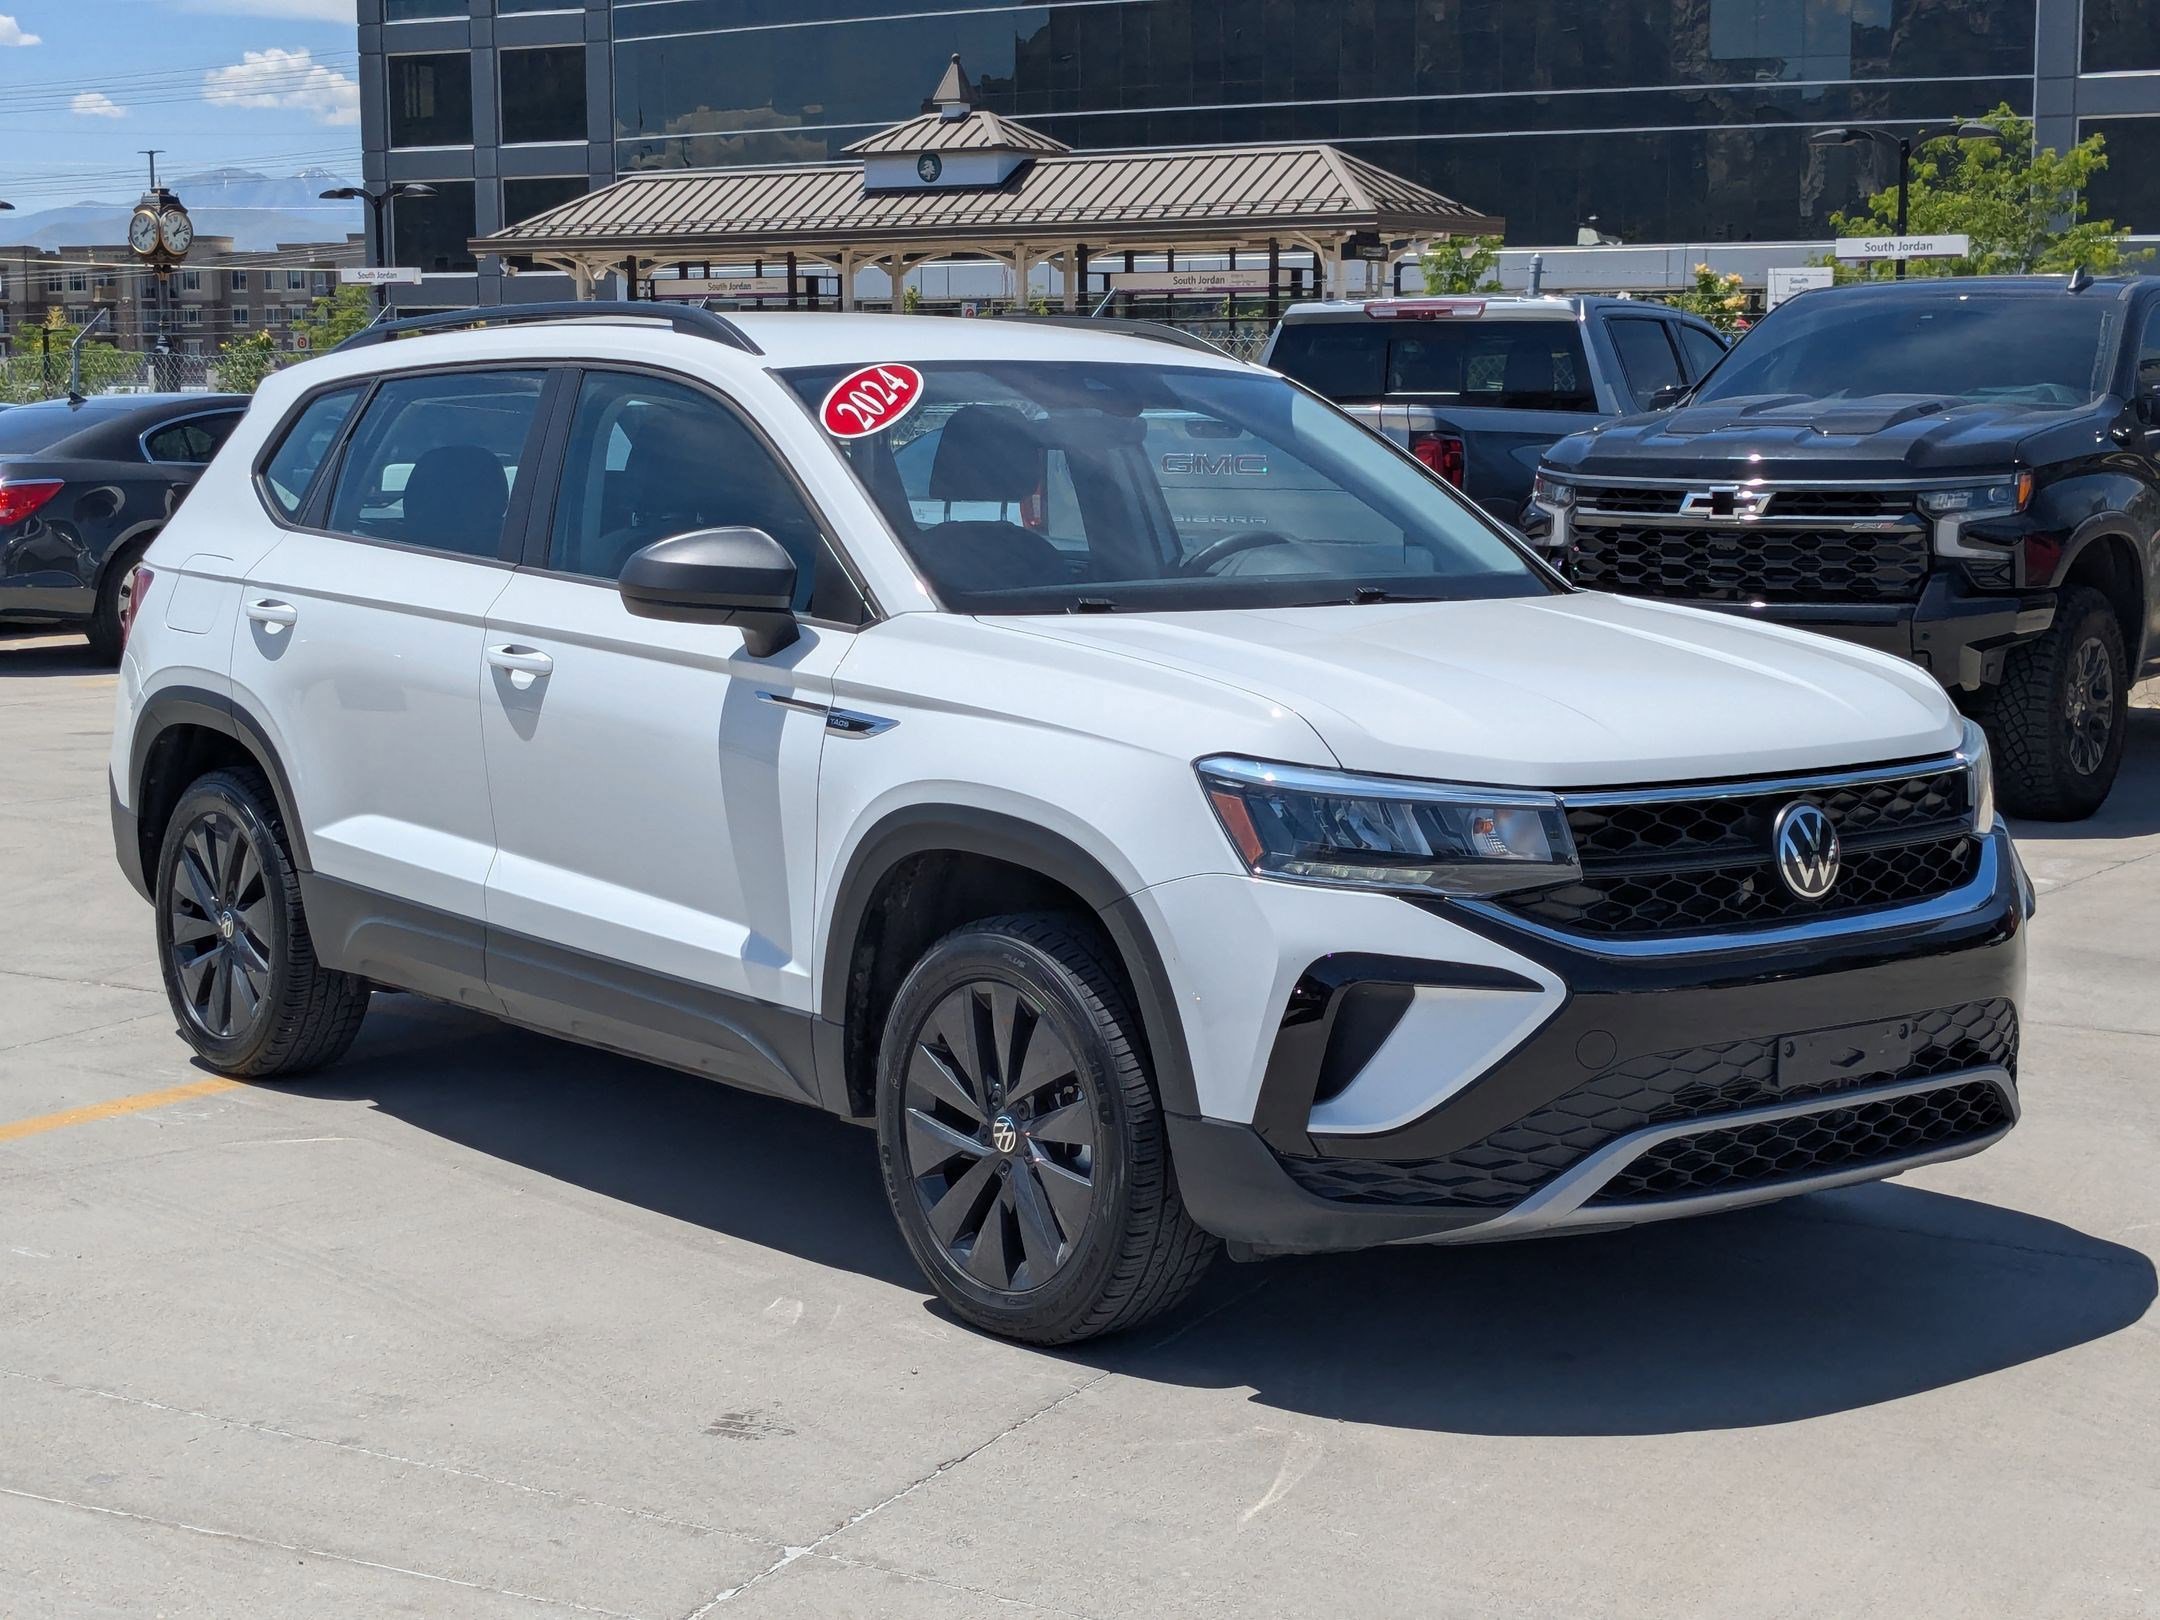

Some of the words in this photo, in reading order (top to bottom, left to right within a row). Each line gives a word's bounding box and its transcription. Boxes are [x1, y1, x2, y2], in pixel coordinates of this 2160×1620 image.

[1864, 241, 1895, 252] South
[1897, 240, 1933, 251] Jordan
[357, 271, 375, 279] South
[377, 271, 397, 279] Jordan
[1173, 275, 1197, 285] South
[1198, 275, 1225, 285] Jordan
[707, 282, 728, 291] South
[728, 281, 752, 290] Jordan
[836, 367, 910, 431] 2024
[1161, 452, 1269, 476] GMC
